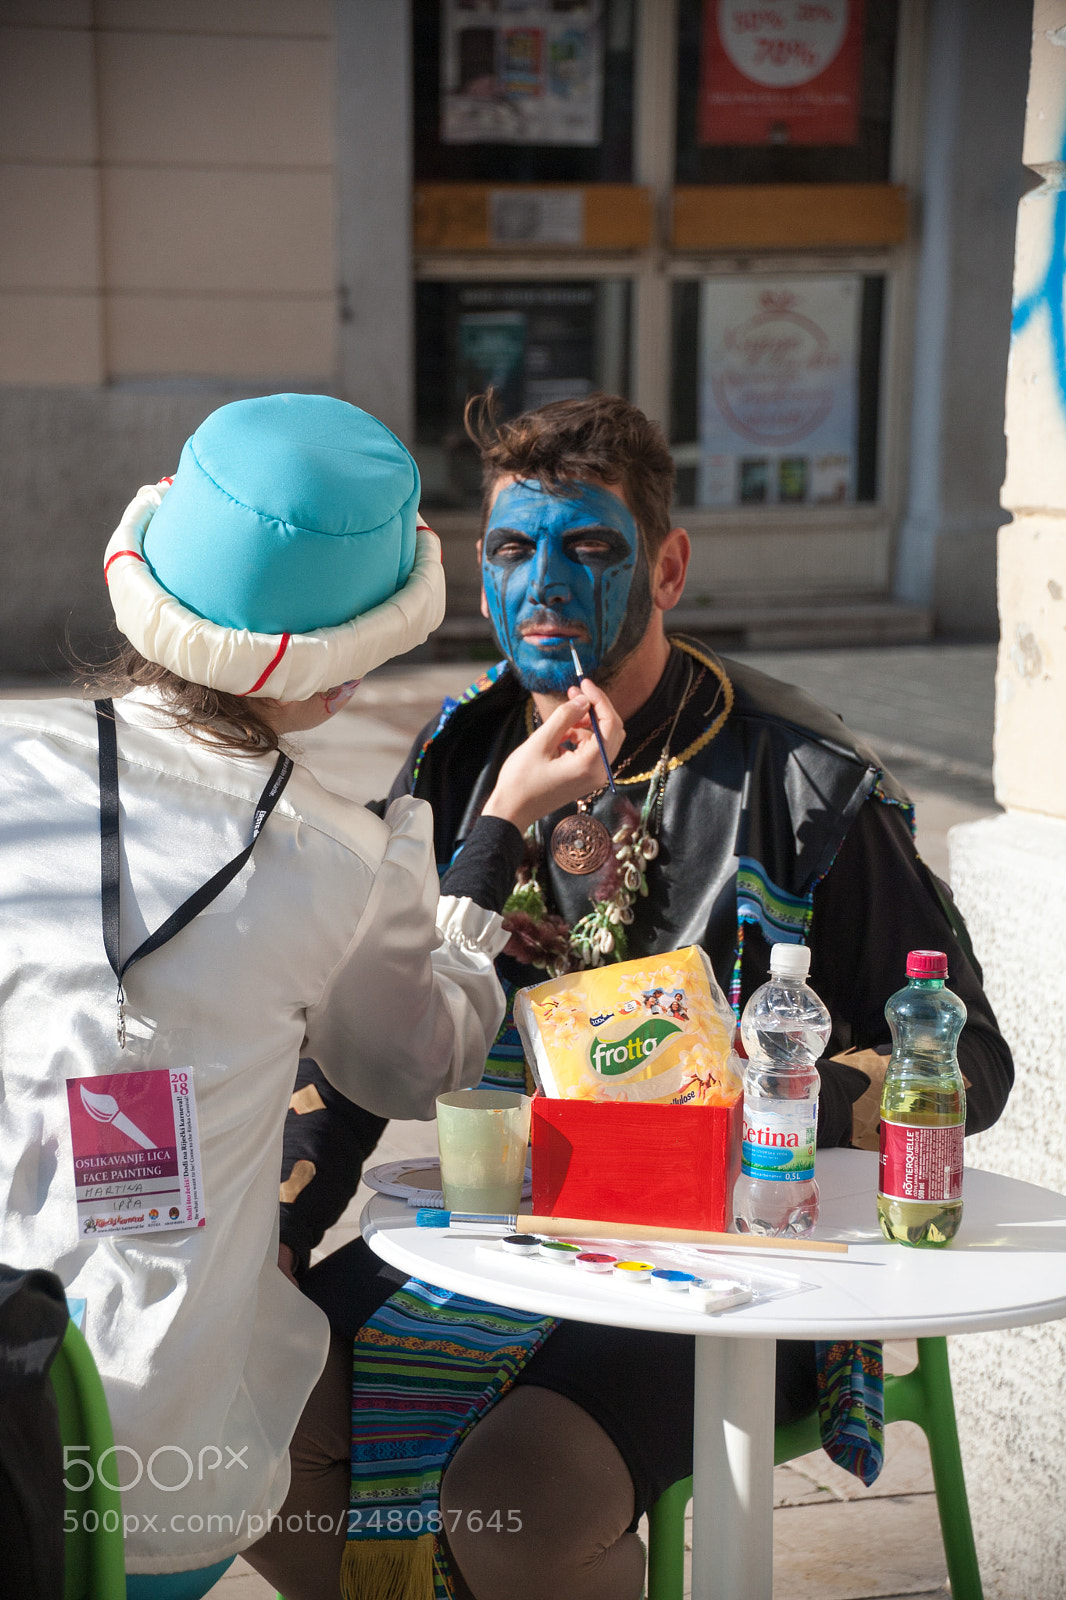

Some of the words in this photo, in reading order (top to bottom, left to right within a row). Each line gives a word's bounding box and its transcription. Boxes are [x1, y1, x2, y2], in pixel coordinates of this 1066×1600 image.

[592, 1037, 658, 1073] frotto
[670, 1090, 696, 1105] llulose
[75, 1153, 145, 1169] OSLIKAVANJE
[147, 1150, 171, 1162] LICA
[83, 1172, 109, 1183] FACE
[111, 1165, 162, 1180] PAINTING
[85, 1183, 143, 1198] MARTINA
